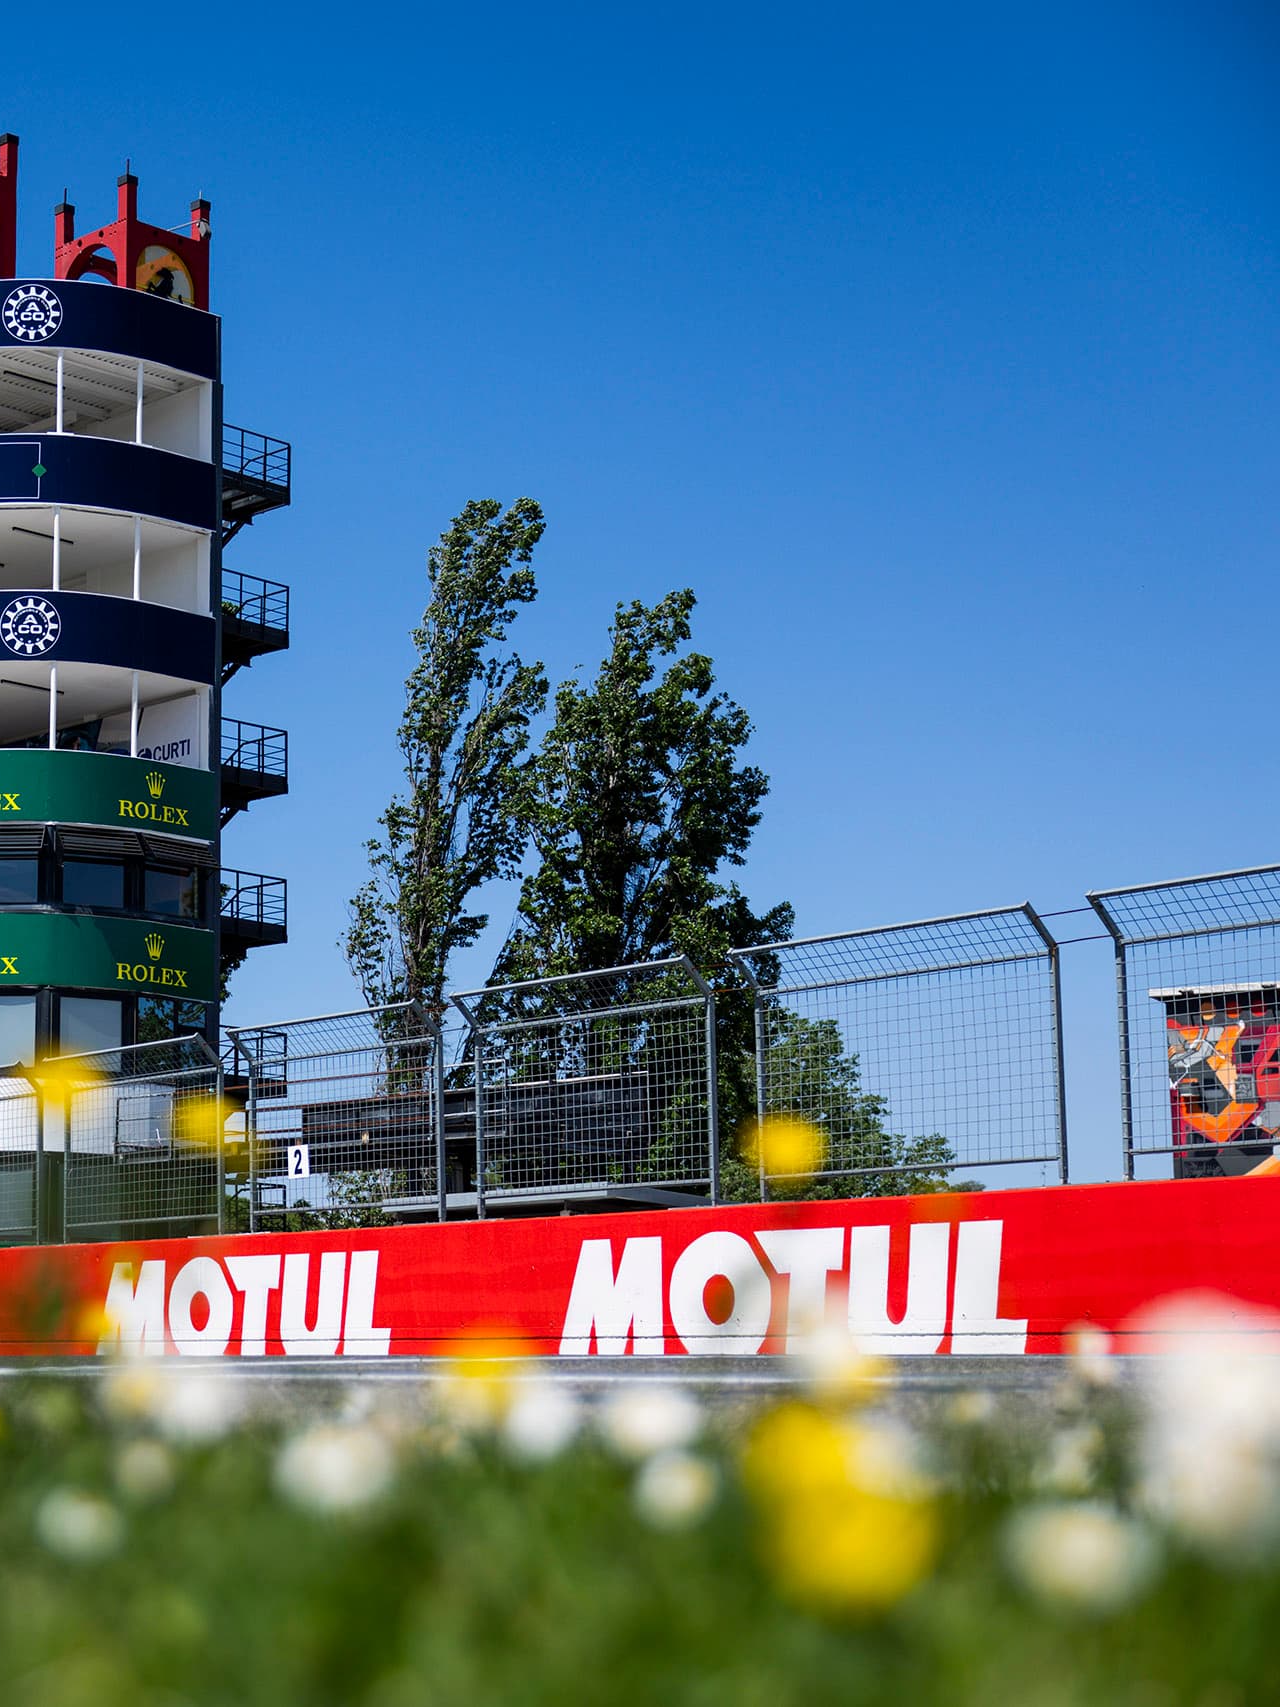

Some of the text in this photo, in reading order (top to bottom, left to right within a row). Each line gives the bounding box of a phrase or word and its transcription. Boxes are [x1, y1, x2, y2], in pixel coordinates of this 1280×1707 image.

[153, 739, 191, 761] CURTI
[118, 799, 189, 827] ROLEX
[117, 963, 188, 989] ROLEX
[293, 1149, 303, 1175] 2
[559, 1219, 1028, 1356] MOTUL
[97, 1249, 392, 1356] MOTUL
